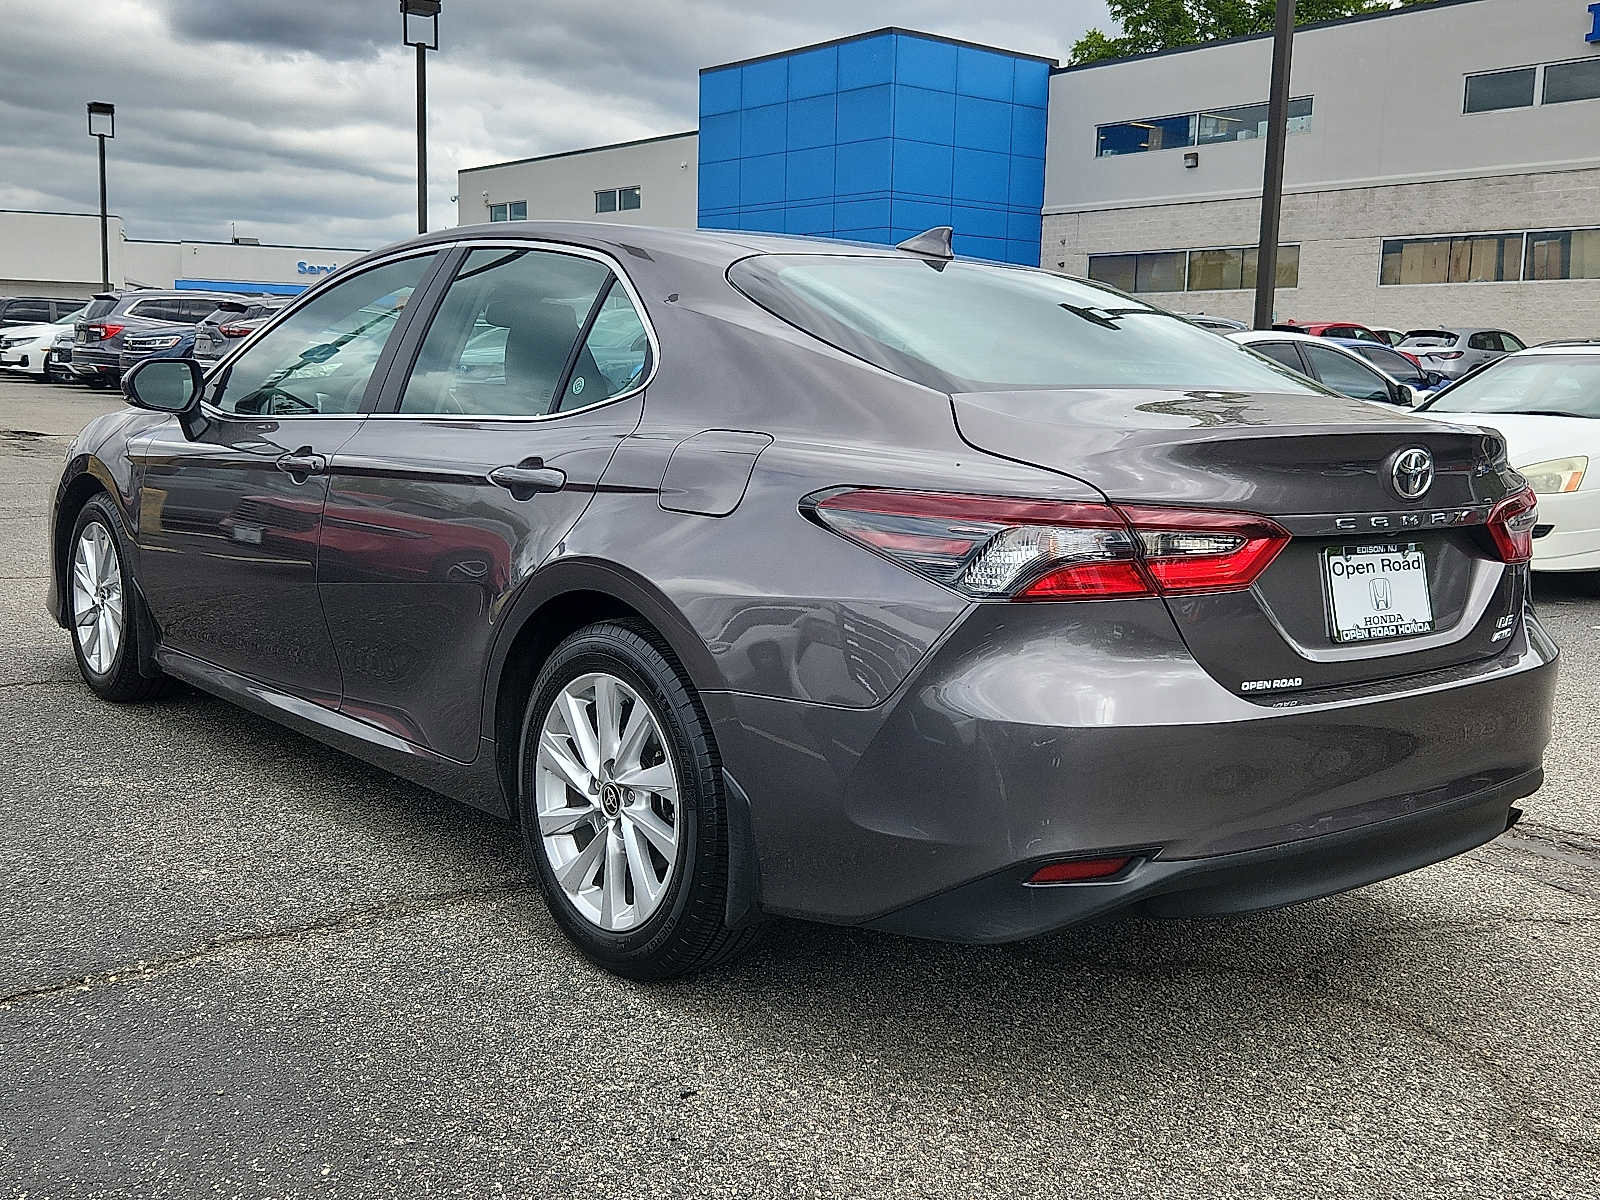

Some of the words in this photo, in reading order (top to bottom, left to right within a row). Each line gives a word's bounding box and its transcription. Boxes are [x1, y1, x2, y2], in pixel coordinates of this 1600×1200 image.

[1387, 544, 1398, 552] NJ
[1332, 560, 1376, 580] Open
[1380, 555, 1421, 573] Road
[1363, 613, 1405, 627] HONDA
[1342, 627, 1370, 641] OPEN
[1370, 625, 1397, 638] ROAD
[1397, 622, 1431, 635] HONDA
[1240, 679, 1272, 691] OPEN
[1272, 677, 1303, 689] ROAD
